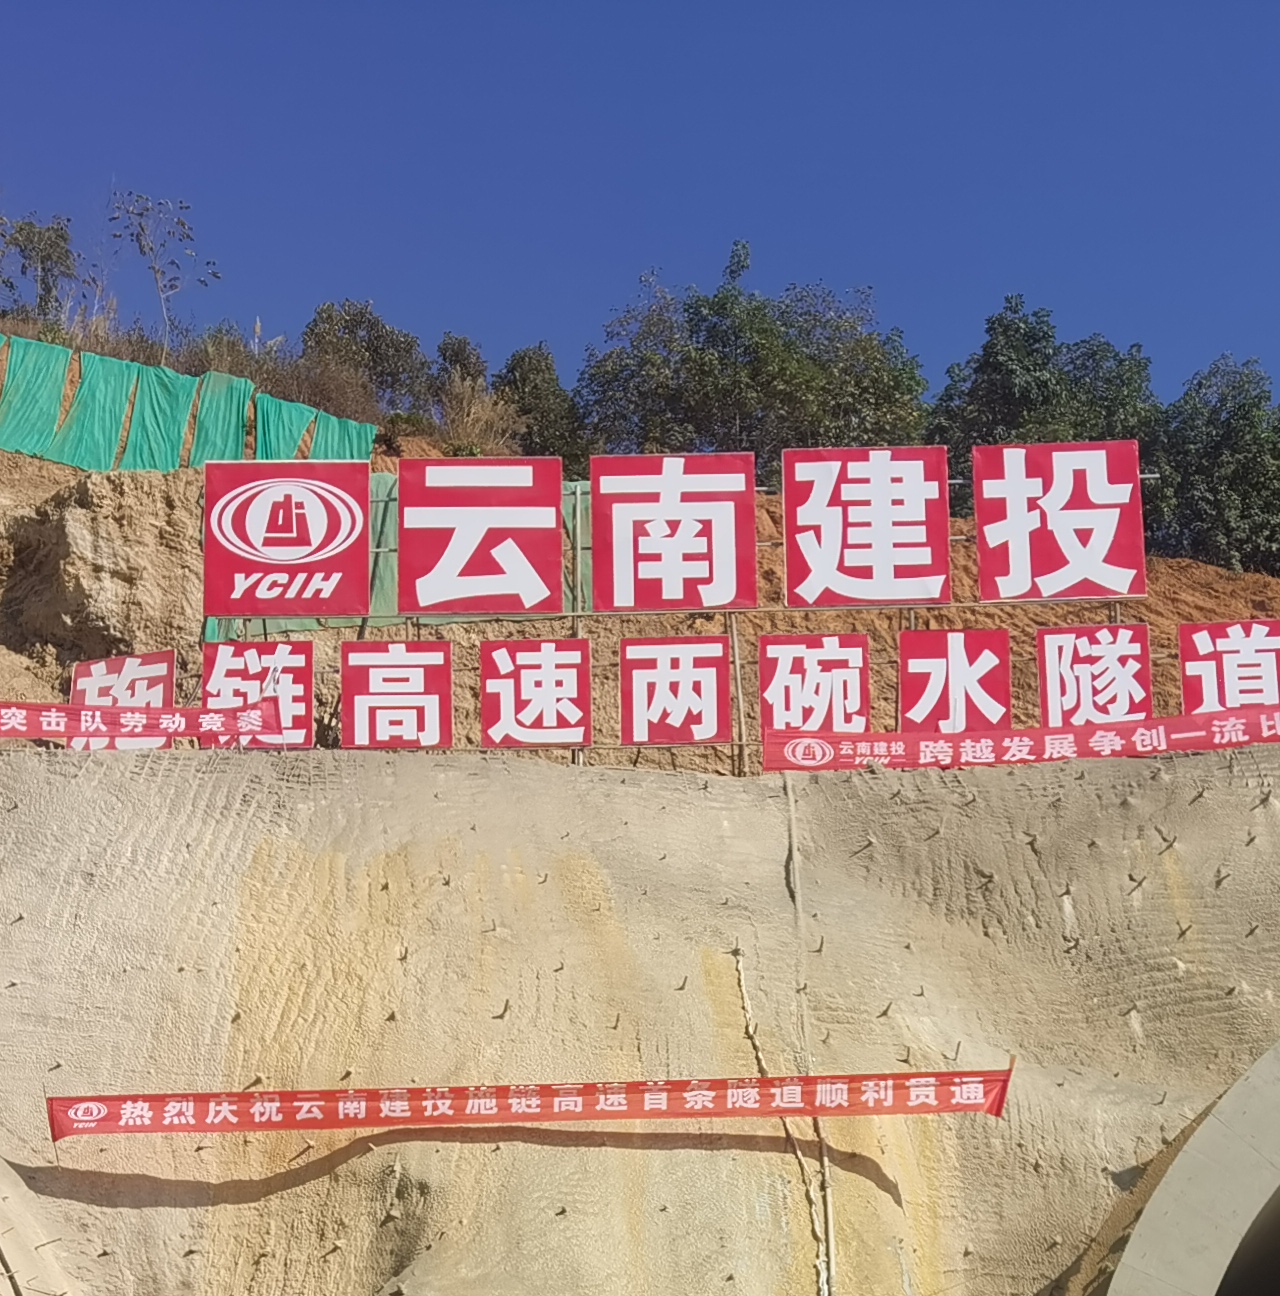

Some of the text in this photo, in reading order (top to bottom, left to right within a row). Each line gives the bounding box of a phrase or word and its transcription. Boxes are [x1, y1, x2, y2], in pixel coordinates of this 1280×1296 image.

[403, 448, 1137, 609] 云南建投
[230, 572, 343, 599] YCIH
[839, 741, 905, 755] 云南建投
[118, 1077, 986, 1125] 热烈庆祝云南建投施链高速首条隧道顺利贯通
